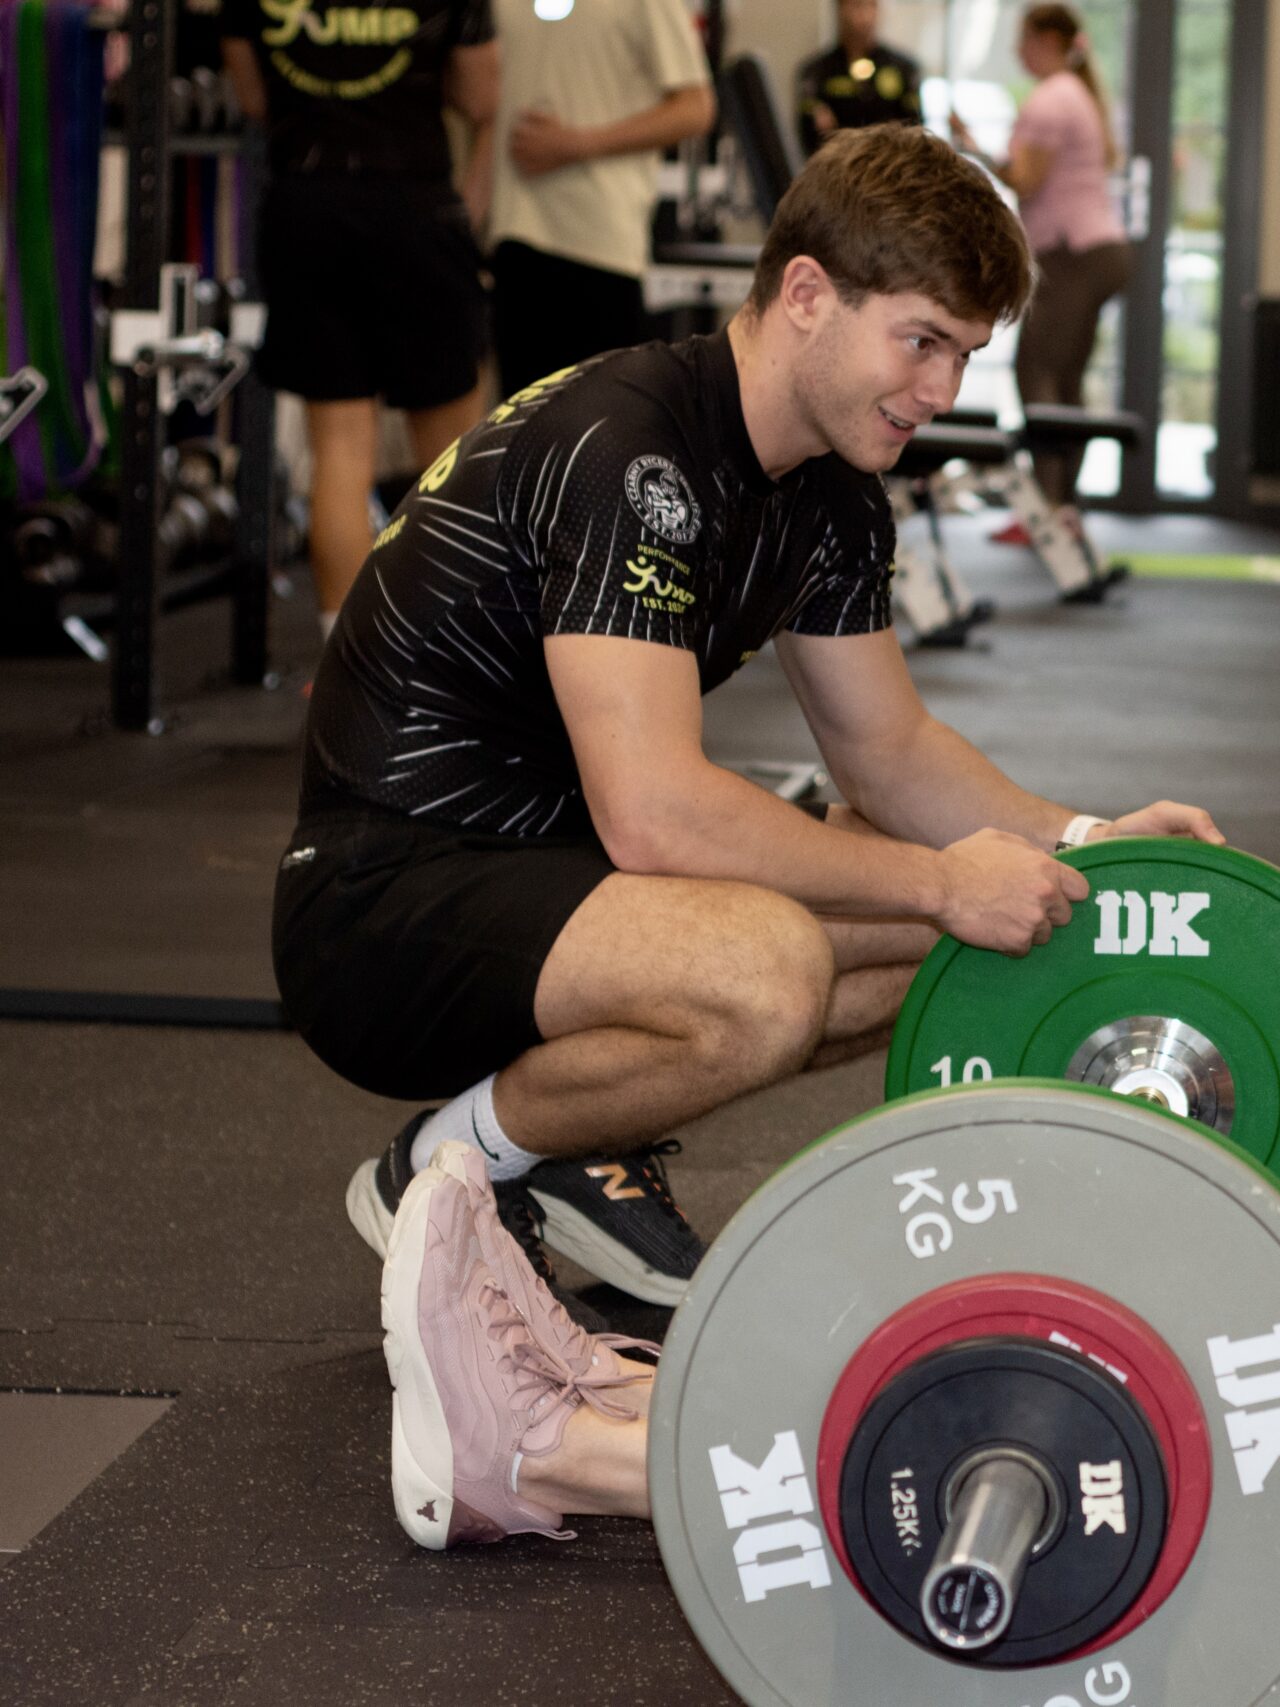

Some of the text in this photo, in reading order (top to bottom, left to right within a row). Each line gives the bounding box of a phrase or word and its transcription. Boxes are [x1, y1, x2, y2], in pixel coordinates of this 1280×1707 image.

[1094, 890, 1210, 957] DK
[893, 1168, 1018, 1259] 5 KG
[708, 1430, 832, 1604] DK
[1079, 1460, 1127, 1536] DK
